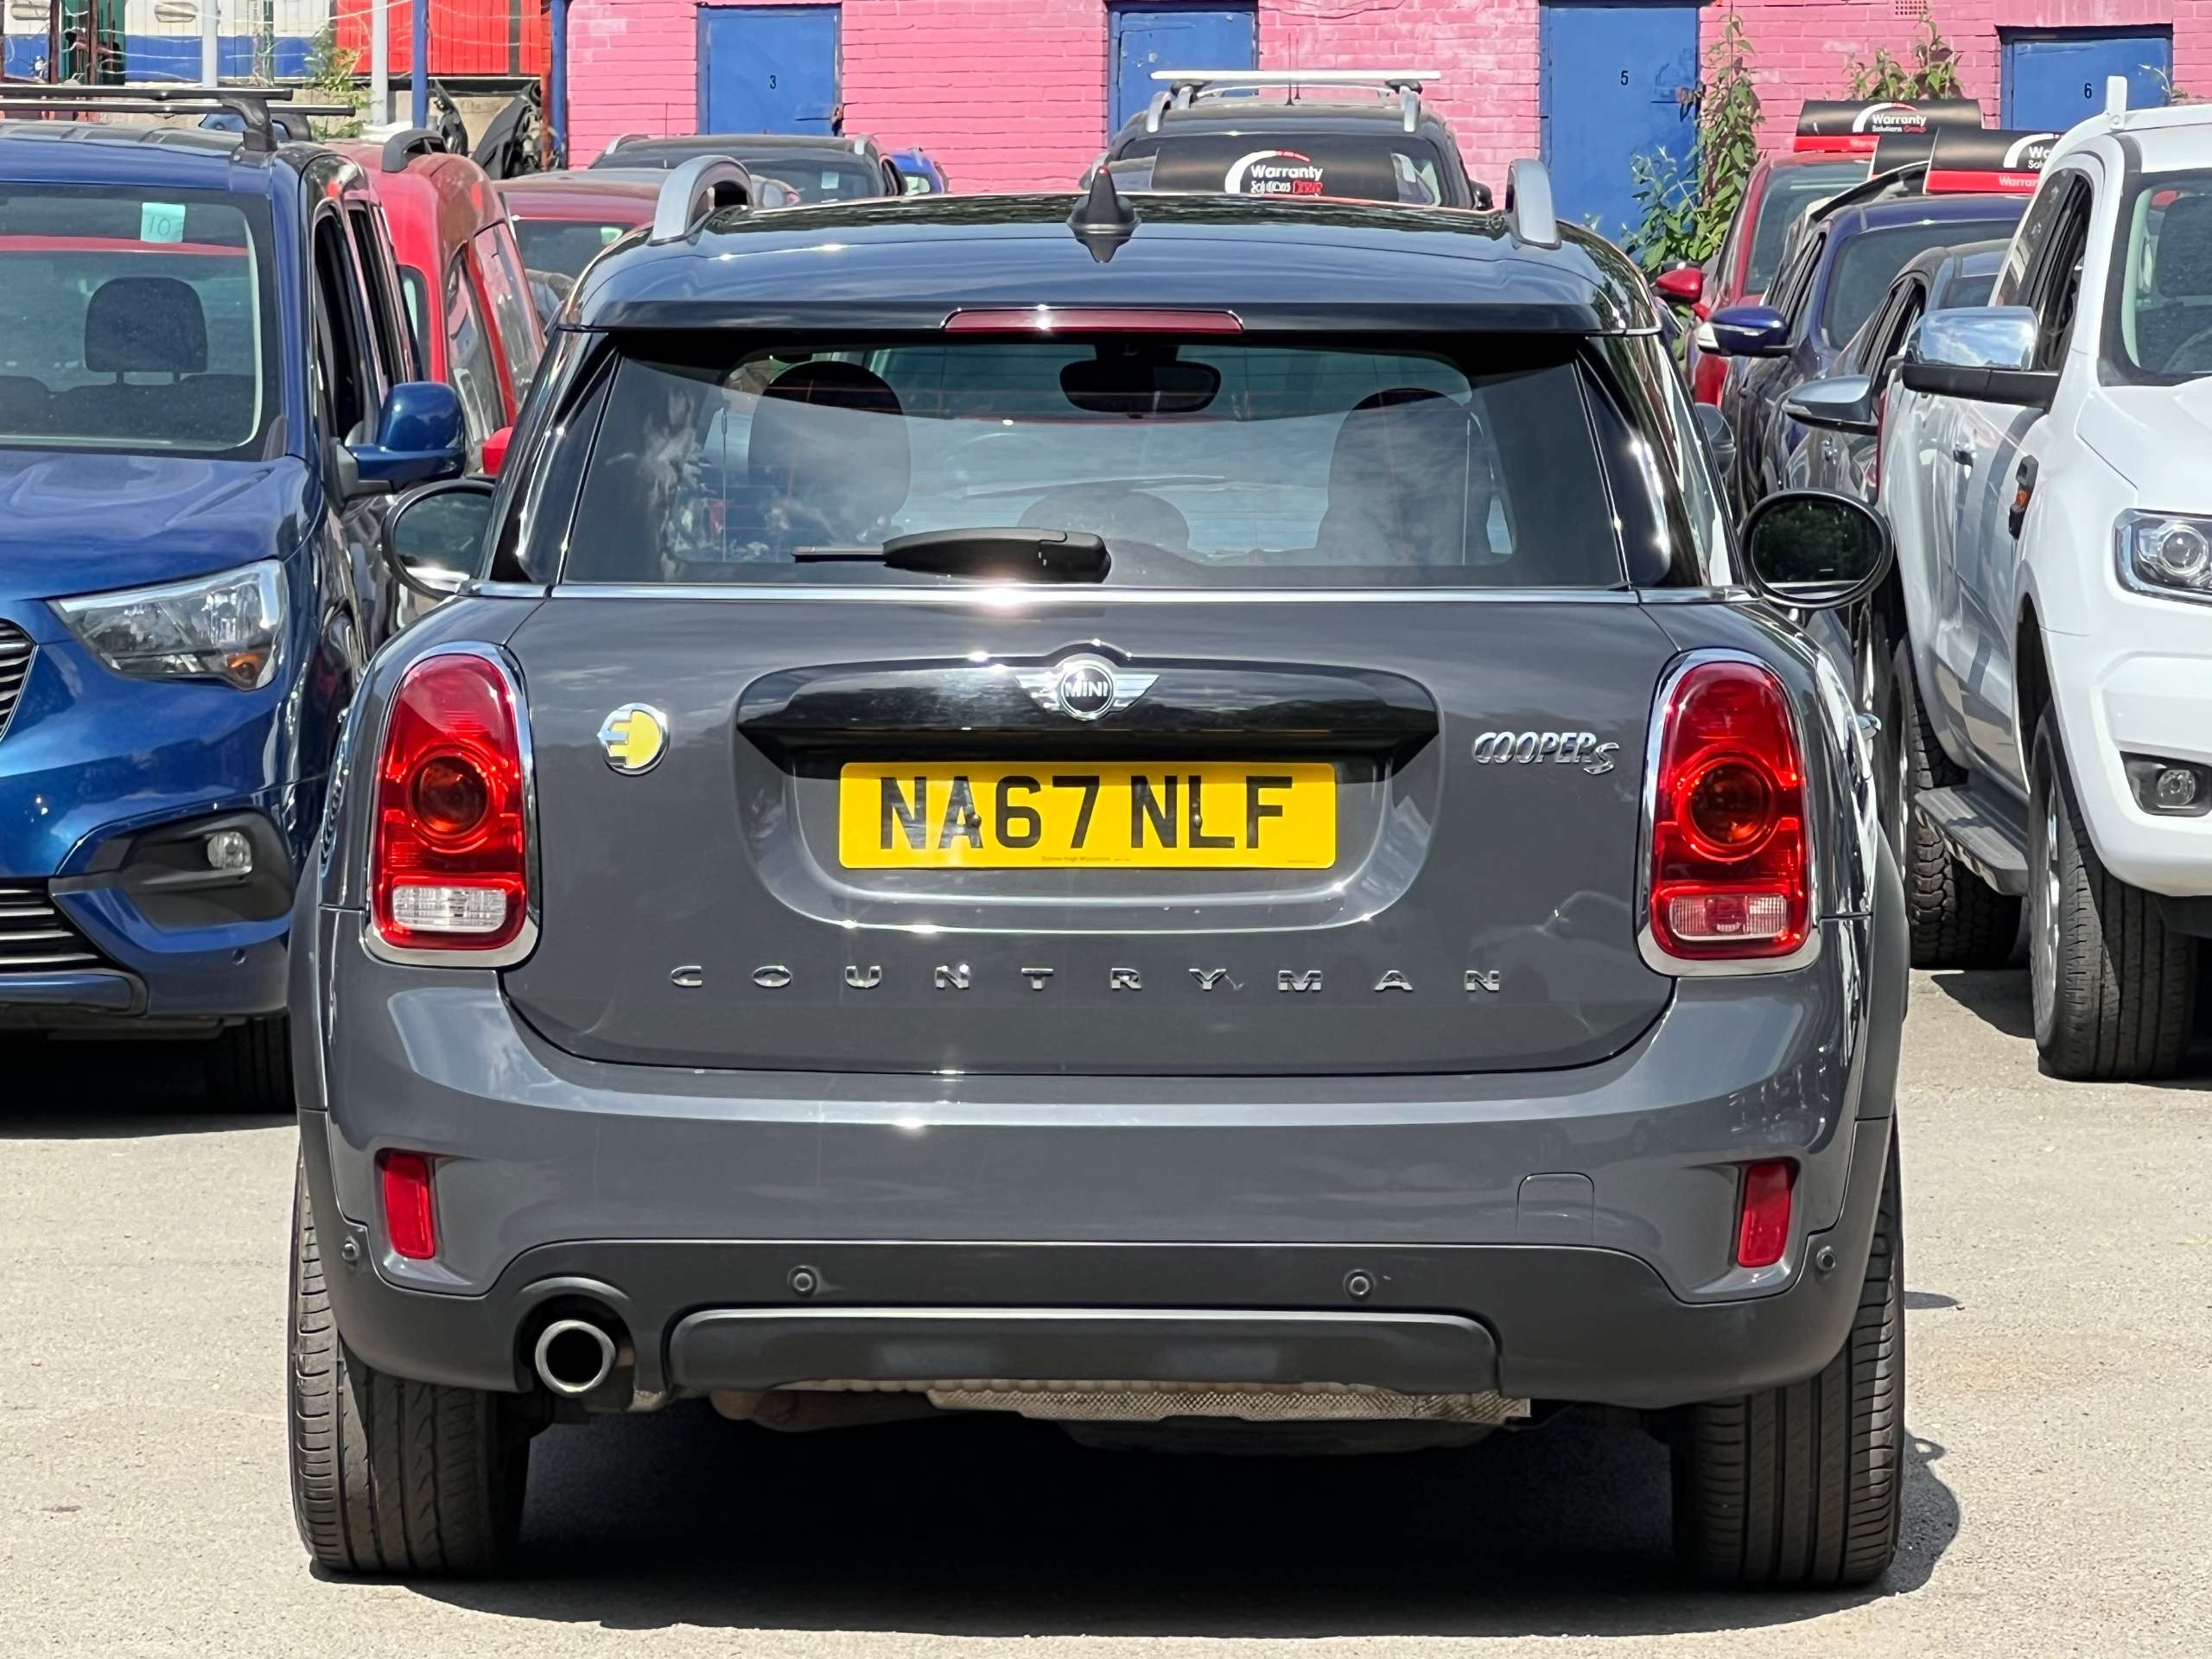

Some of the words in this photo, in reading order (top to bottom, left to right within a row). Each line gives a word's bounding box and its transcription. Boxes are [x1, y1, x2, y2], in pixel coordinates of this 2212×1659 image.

[769, 74, 777, 90] 3
[1620, 70, 1629, 86] 5
[2084, 83, 2093, 99] 6
[1872, 114, 1927, 127] Warranty
[1250, 164, 1324, 181] Warranty
[1999, 175, 2040, 188] Warran
[149, 215, 171, 237] 10
[1065, 681, 1109, 697] MINI
[1473, 732, 1597, 764] COOPER
[1583, 741, 1620, 775] S
[880, 775, 1100, 849] NA67
[1130, 775, 1293, 849] NLF
[670, 964, 1501, 993] COUNTRYMAN
